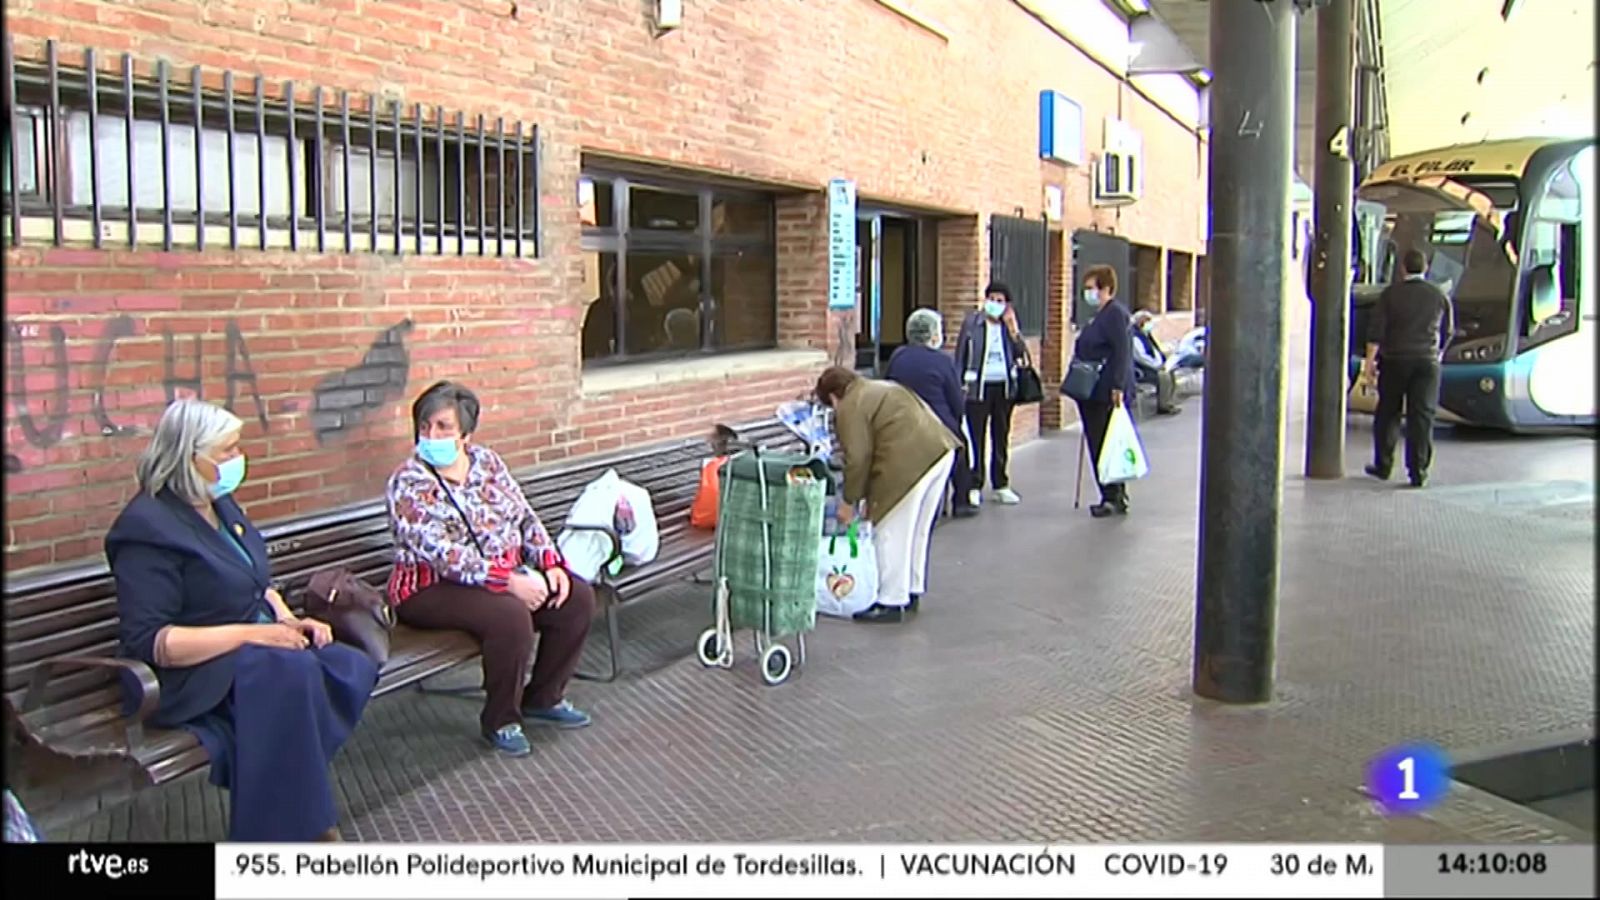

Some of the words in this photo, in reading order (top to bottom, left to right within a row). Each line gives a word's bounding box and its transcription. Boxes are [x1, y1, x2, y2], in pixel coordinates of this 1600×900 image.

[1237, 109, 1265, 139] 4
[1329, 126, 1350, 161] 4
[1390, 164, 1411, 177] EL
[1414, 160, 1475, 174] PILAR
